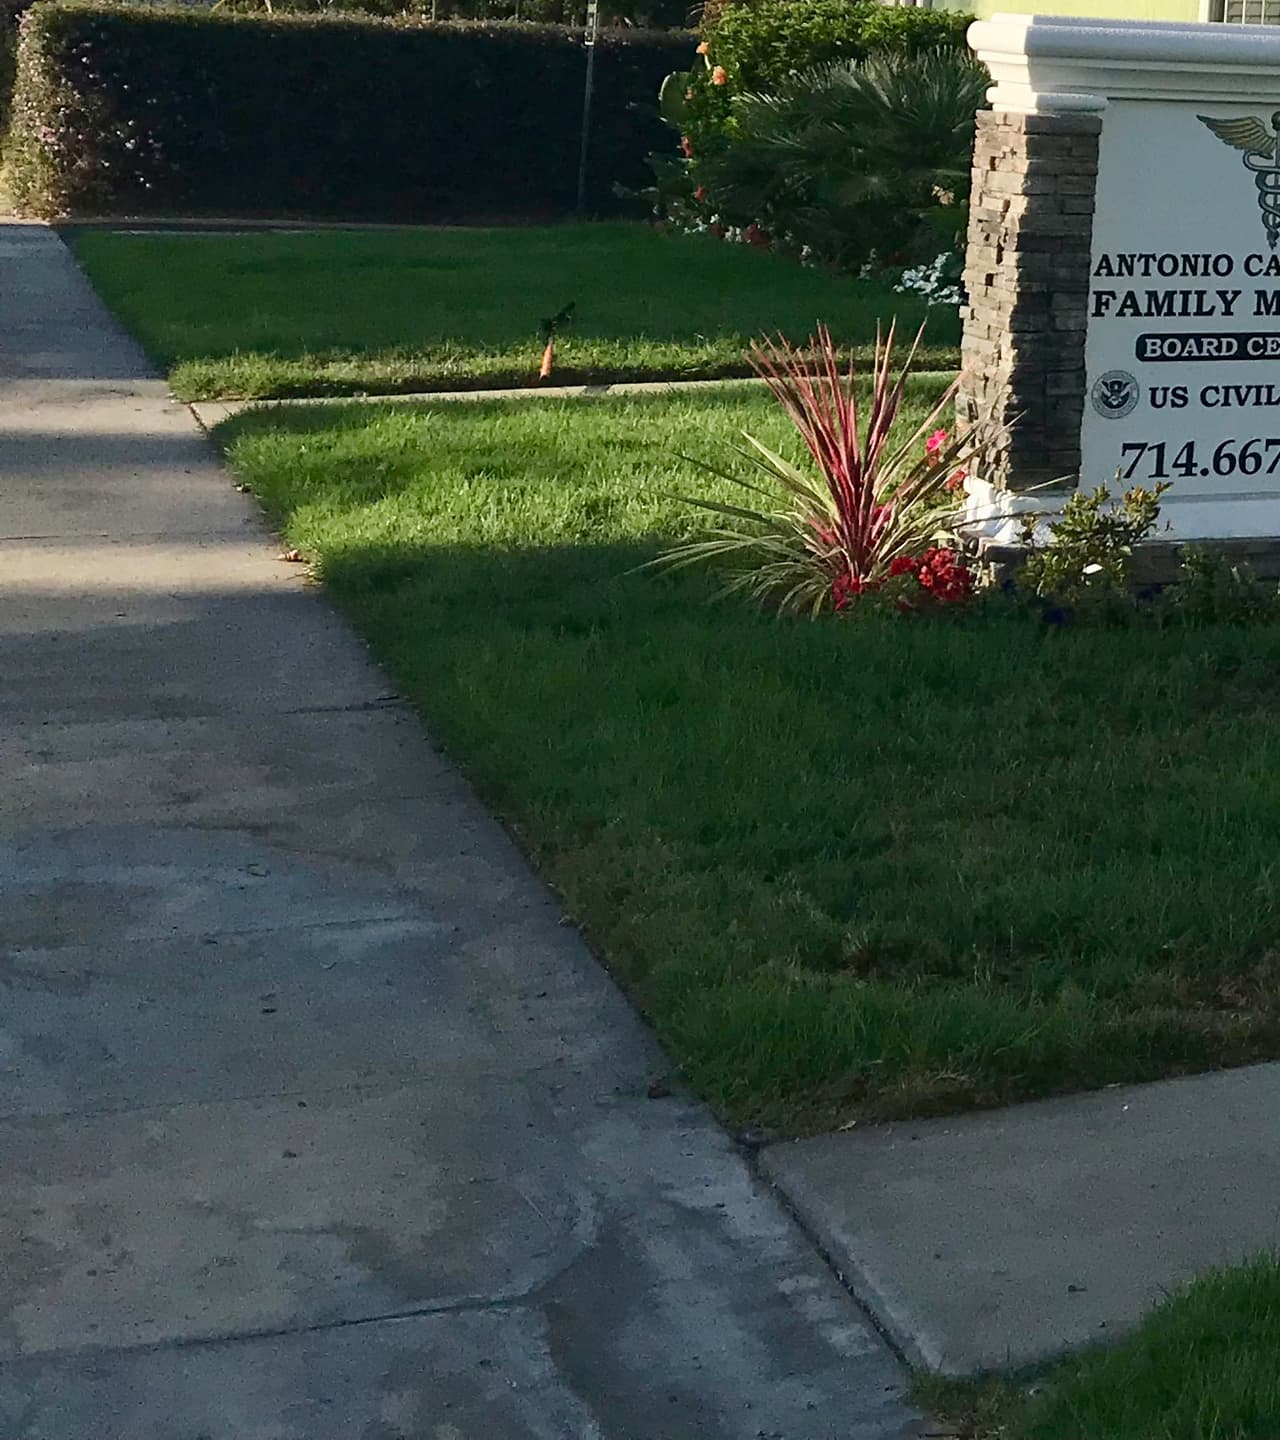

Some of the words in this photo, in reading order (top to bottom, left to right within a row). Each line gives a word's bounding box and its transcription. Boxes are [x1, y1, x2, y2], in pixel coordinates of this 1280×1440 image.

[1093, 253, 1234, 278] ANTONIO
[1091, 289, 1242, 318] FAMILY
[1143, 337, 1239, 358] BOARD
[1148, 385, 1189, 409] US
